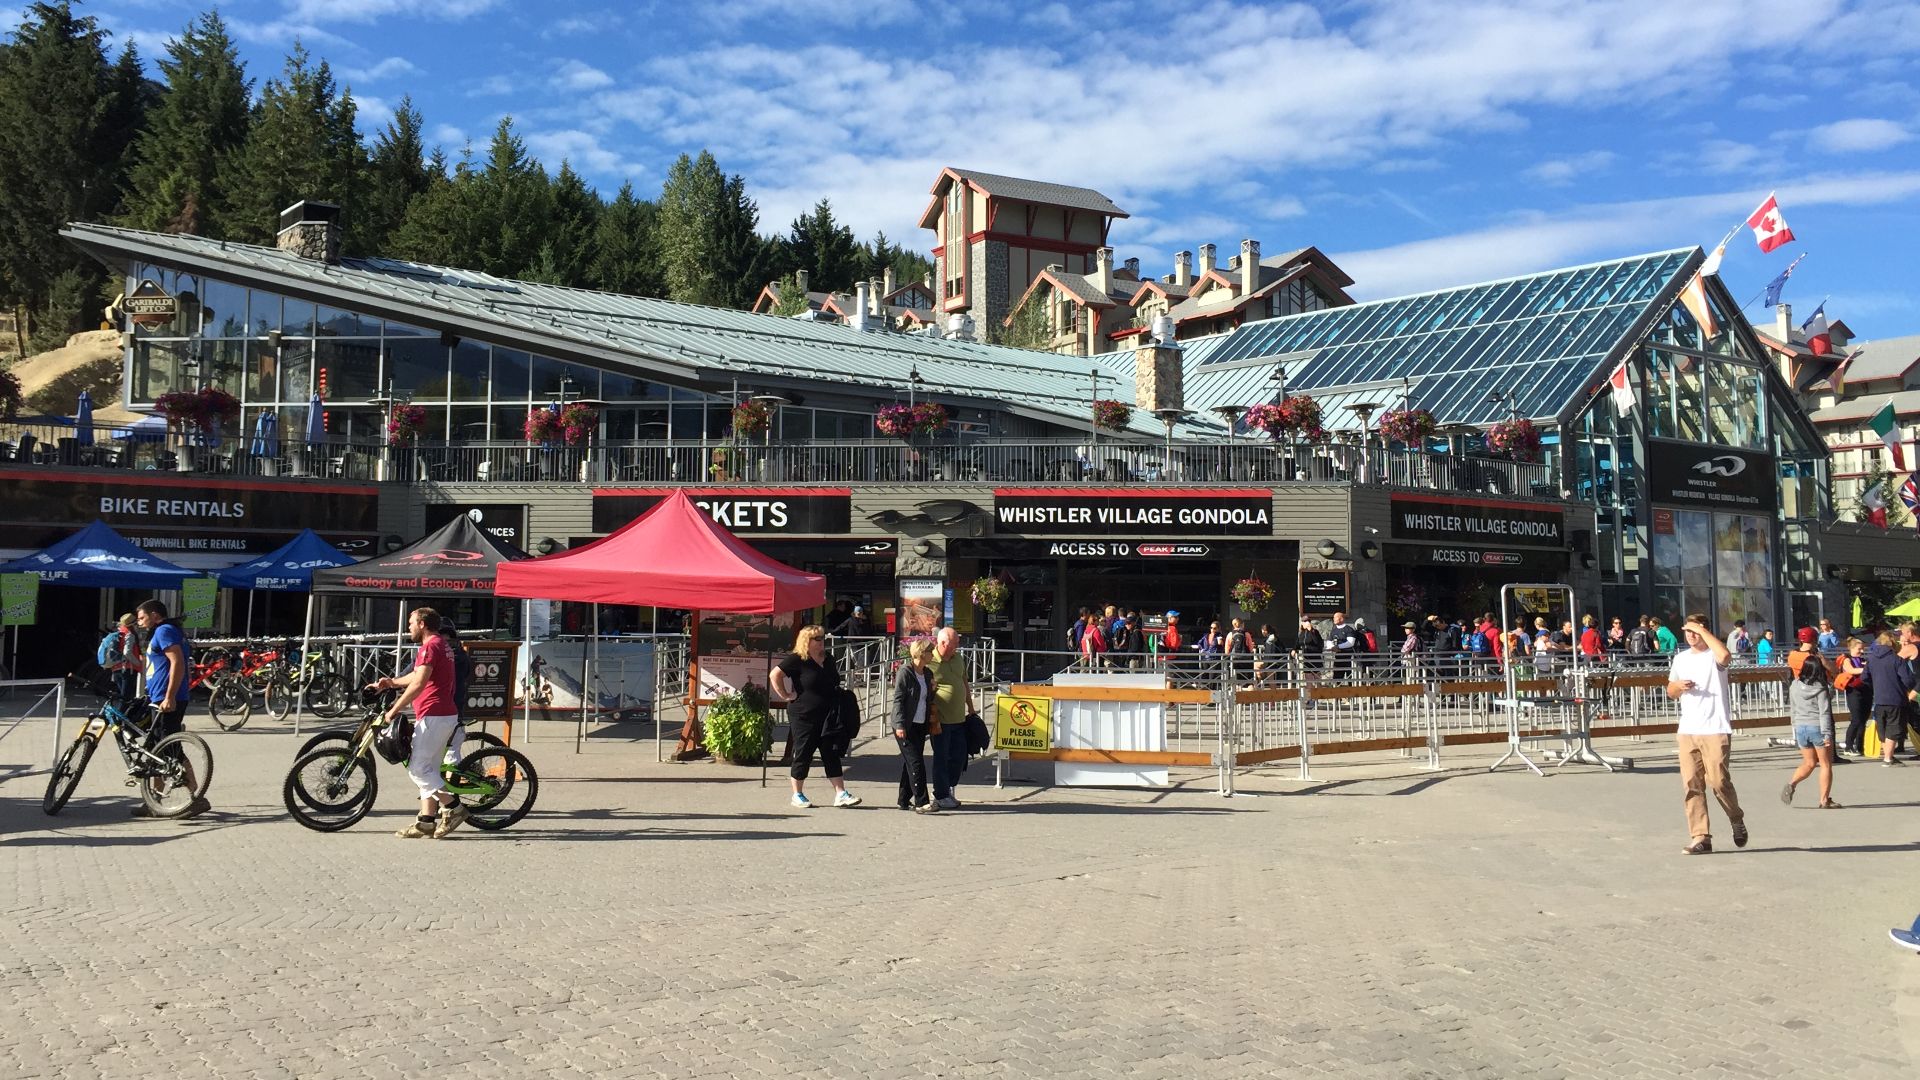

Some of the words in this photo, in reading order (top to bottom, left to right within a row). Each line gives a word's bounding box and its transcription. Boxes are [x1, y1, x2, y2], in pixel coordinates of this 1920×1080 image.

[126, 299, 173, 307] GARIBALDI
[1688, 479, 1717, 487] WHISTLER
[100, 497, 149, 515] BIKE
[156, 500, 245, 518] RENTALS
[999, 507, 1092, 523] WHISTLER
[1097, 508, 1173, 524] VILLAGE
[1178, 509, 1268, 525] GONDOLA
[1404, 513, 1462, 532] WHISTLER
[1465, 518, 1507, 534] VILLAGE
[1510, 521, 1558, 537] GONDOLA
[486, 527, 515, 537] VICES
[143, 537, 186, 548] DOWNHILL
[188, 538, 208, 549] BIKE
[210, 539, 246, 550] RENTALS
[1050, 543, 1105, 556] ACCESS
[1110, 543, 1129, 556] TO
[1432, 550, 1466, 562] ACCESS
[1468, 551, 1480, 563] TO
[49, 571, 69, 579] LIFE
[255, 577, 279, 586] RIDE
[344, 577, 393, 590] Geology
[396, 577, 418, 588] and
[421, 578, 467, 591] Ecology
[1009, 728, 1036, 737] PLEASE
[1002, 738, 1021, 746] WALK
[1023, 739, 1044, 747] BIKES
